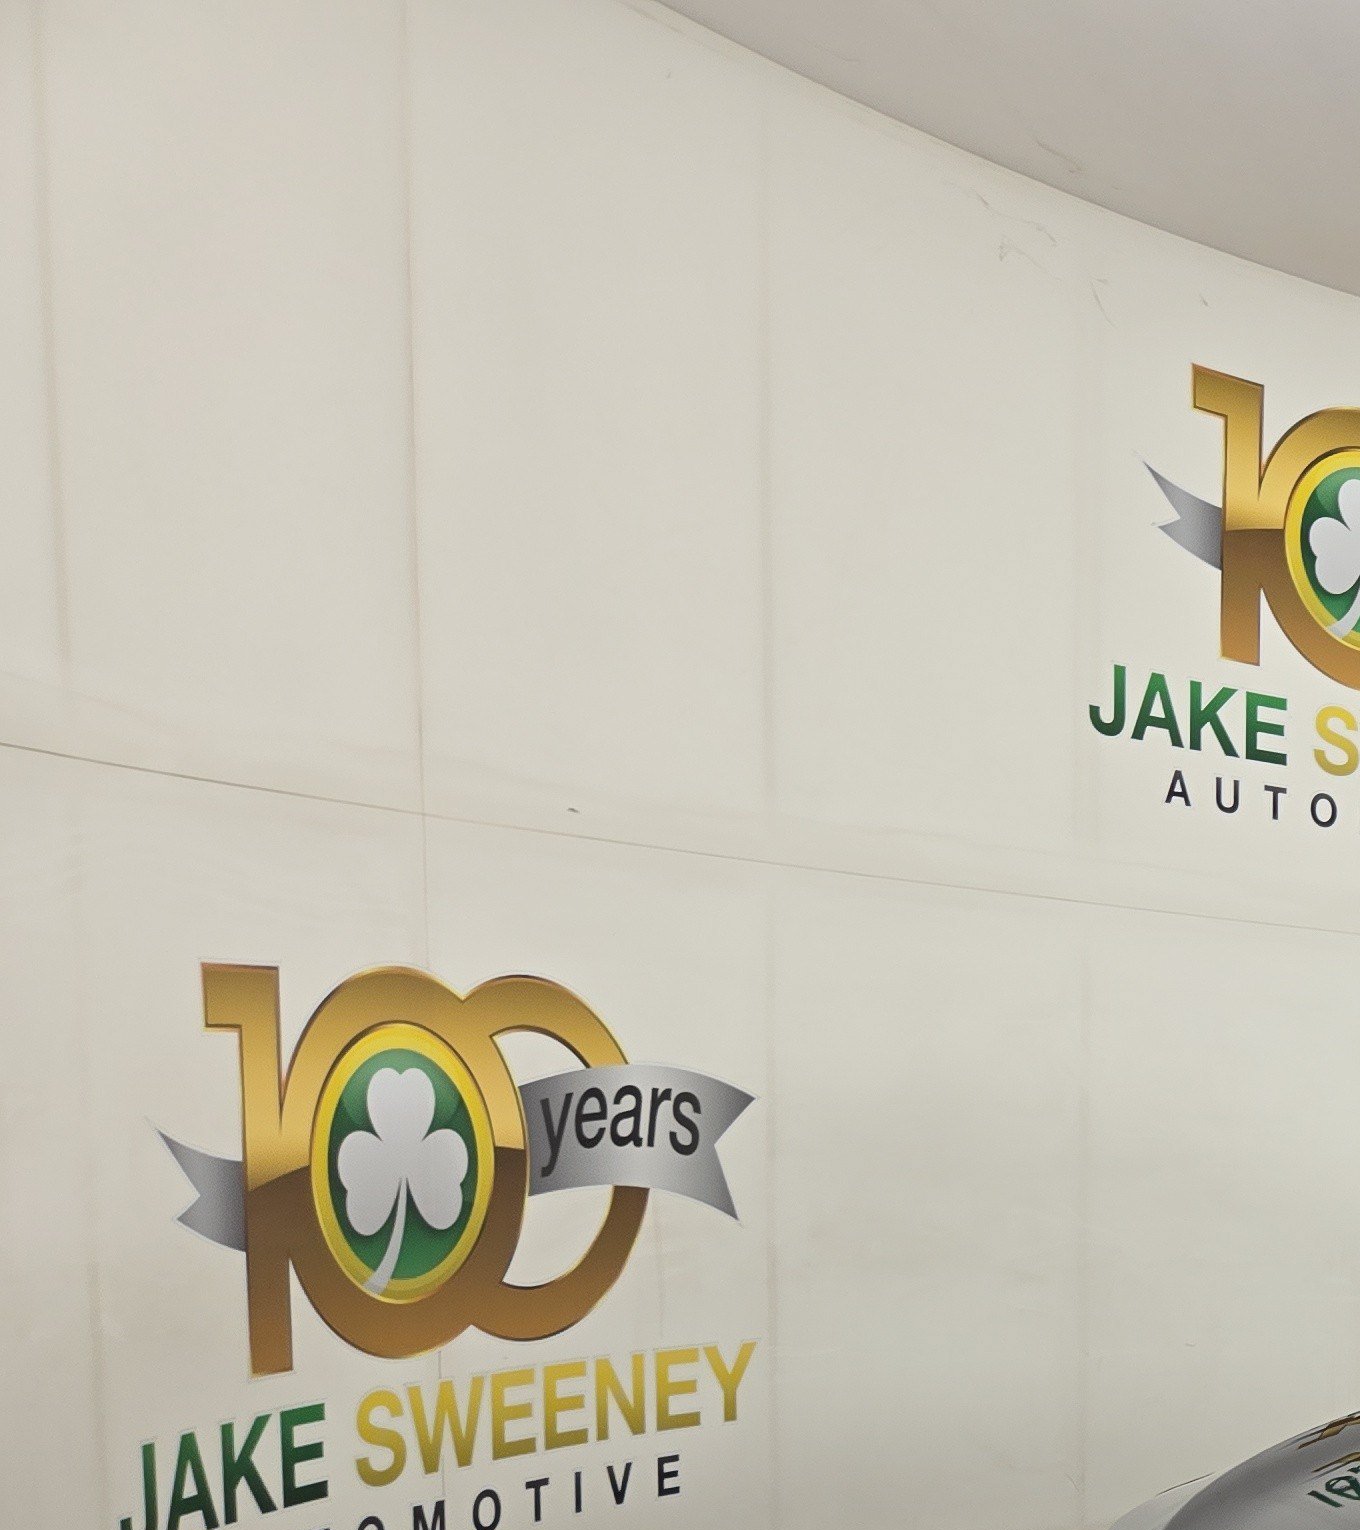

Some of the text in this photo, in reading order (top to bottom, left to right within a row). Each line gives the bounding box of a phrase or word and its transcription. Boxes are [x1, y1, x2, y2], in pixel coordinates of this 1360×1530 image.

[1088, 664, 1289, 766] JAKE
[200, 962, 702, 1378] 100 years
[354, 1342, 757, 1488] SWEENEY
